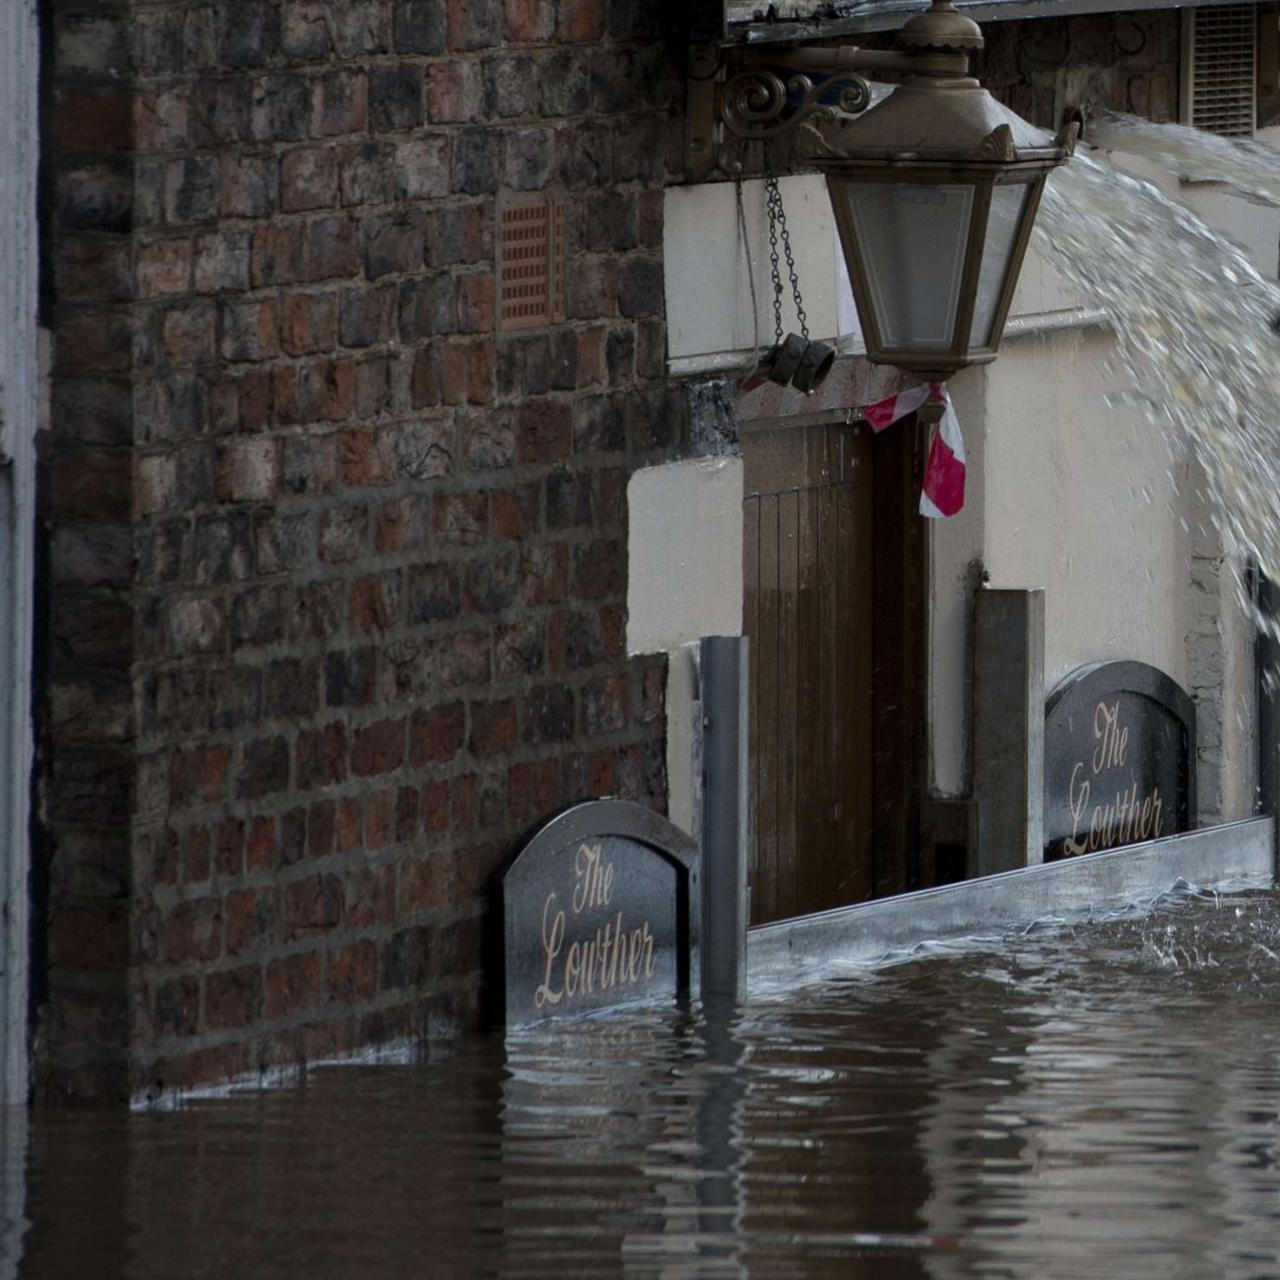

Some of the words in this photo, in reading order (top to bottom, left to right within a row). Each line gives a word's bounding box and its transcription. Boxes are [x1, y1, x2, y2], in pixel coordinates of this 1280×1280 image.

[1093, 702, 1128, 775] The
[1064, 761, 1164, 856] Lowther
[573, 843, 613, 914] The
[535, 892, 657, 1008] Lowther
